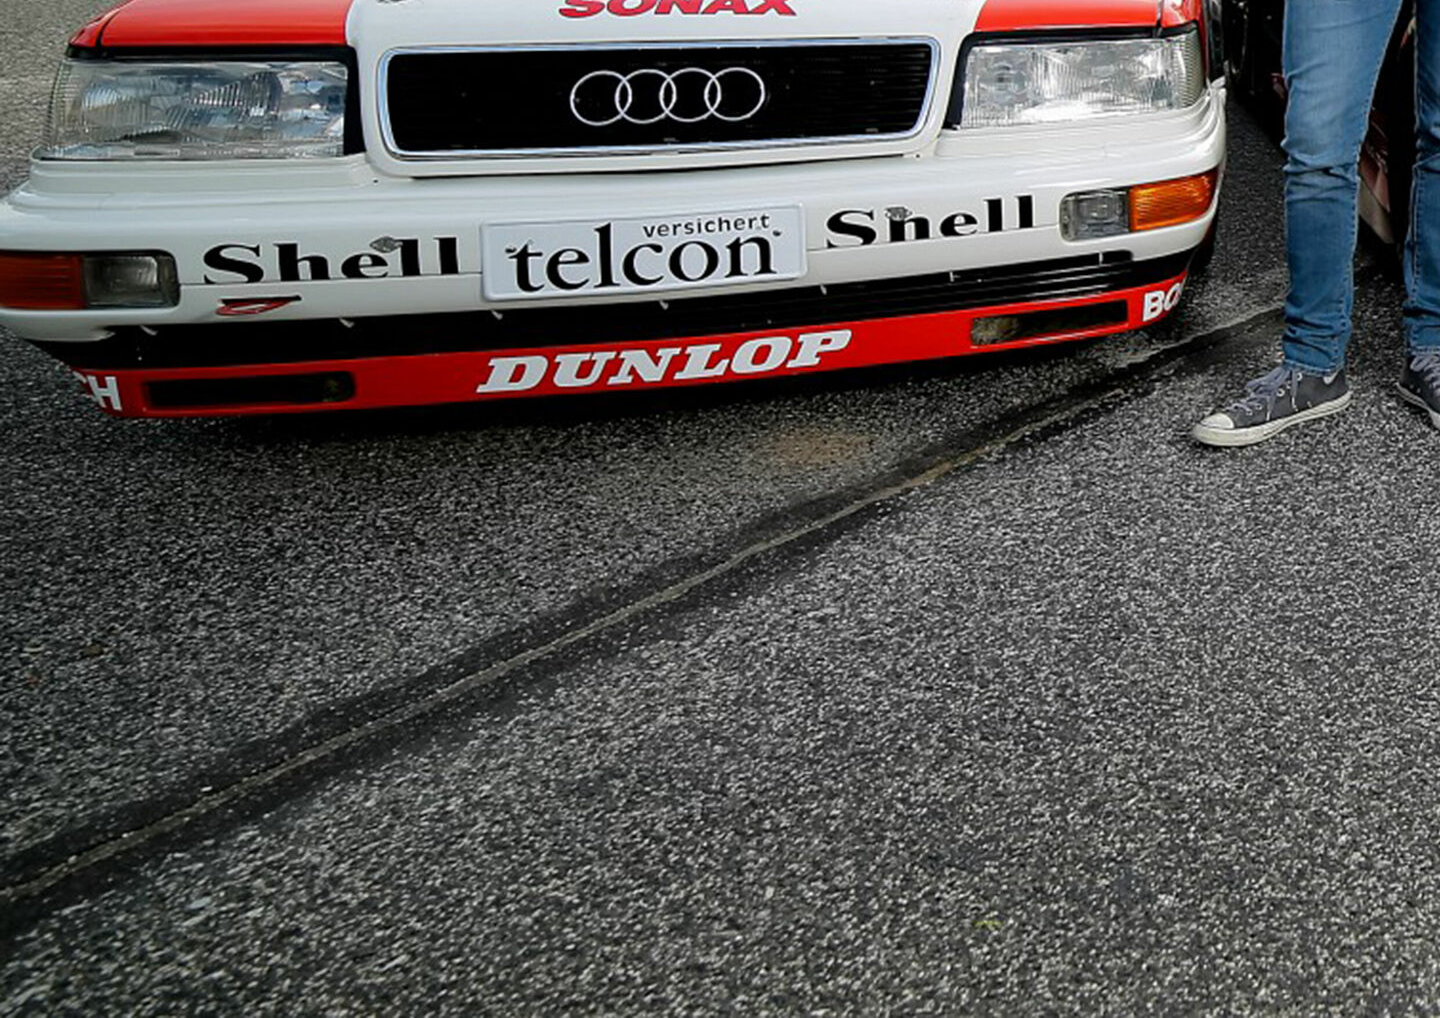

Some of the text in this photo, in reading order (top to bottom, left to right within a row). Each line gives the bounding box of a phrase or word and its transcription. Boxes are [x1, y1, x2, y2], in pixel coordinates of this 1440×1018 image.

[643, 214, 772, 238] versichert
[825, 194, 1036, 250] Shell
[203, 237, 459, 285] Shell
[505, 222, 778, 292] telcon
[476, 329, 852, 393] DUNLOP
